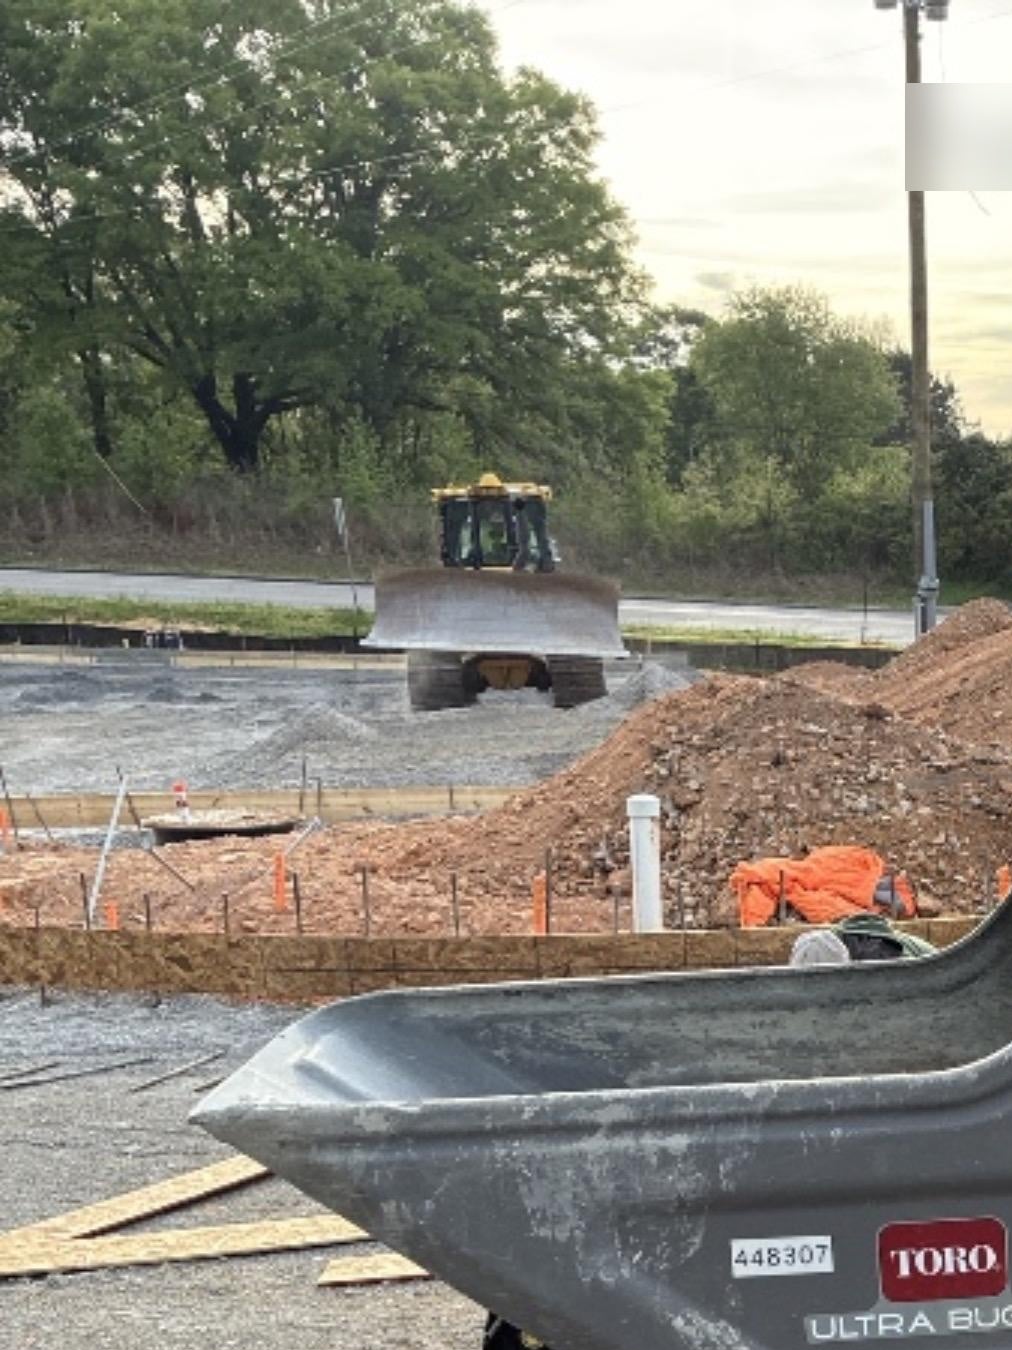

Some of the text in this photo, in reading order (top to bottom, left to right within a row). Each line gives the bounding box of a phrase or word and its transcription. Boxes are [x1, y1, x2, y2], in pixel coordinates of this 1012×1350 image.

[734, 1245, 829, 1267] 448307
[890, 1244, 998, 1279] TORO
[811, 1310, 936, 1340] ULTRA
